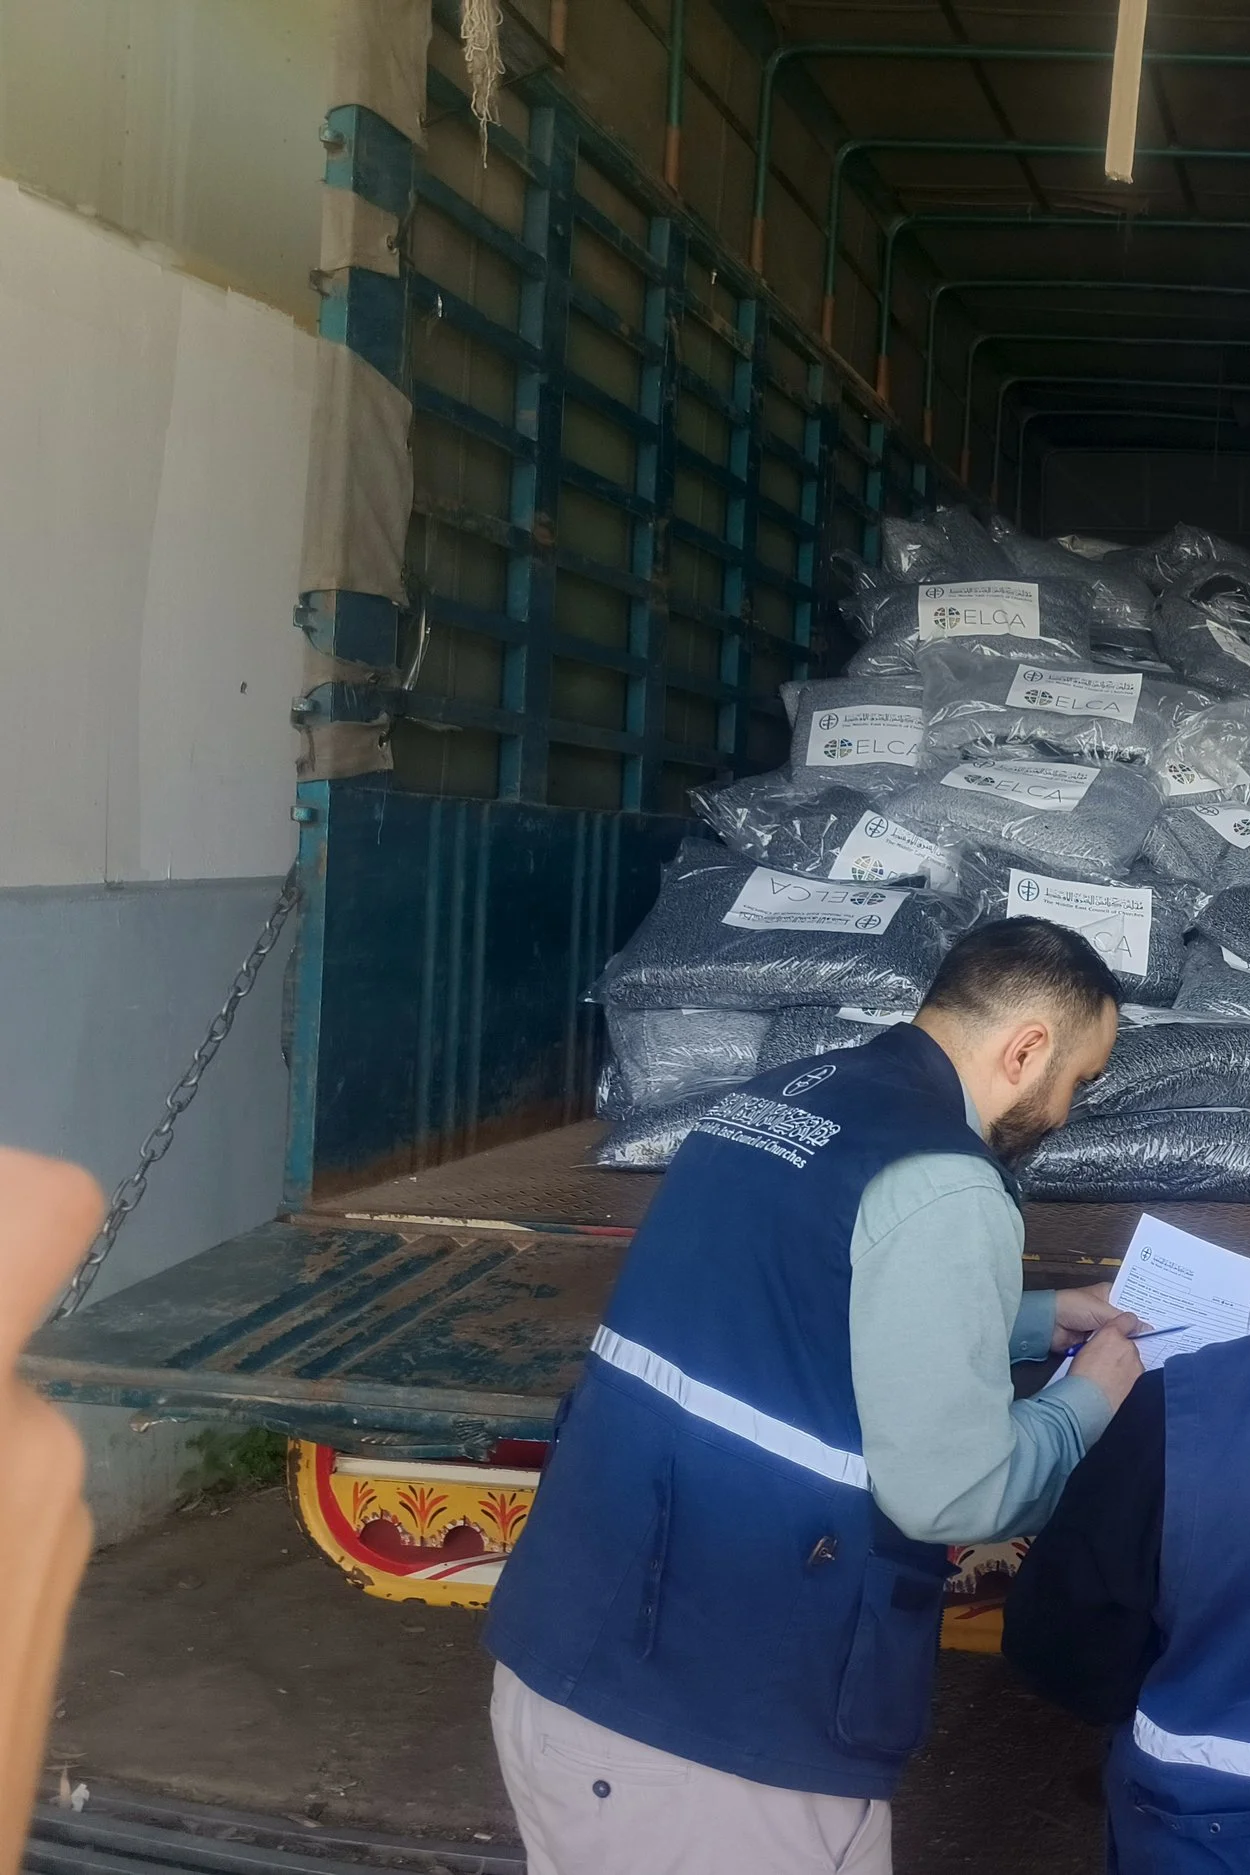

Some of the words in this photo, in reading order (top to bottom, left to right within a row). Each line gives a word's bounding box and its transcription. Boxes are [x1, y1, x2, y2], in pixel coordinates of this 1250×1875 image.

[964, 609, 1026, 628] ELCA
[1055, 695, 1121, 713] ELCA
[994, 780, 1063, 803] ELCA
[770, 877, 849, 904] ELCA
[717, 1126, 736, 1139] East
[764, 1140, 807, 1168] Churches
